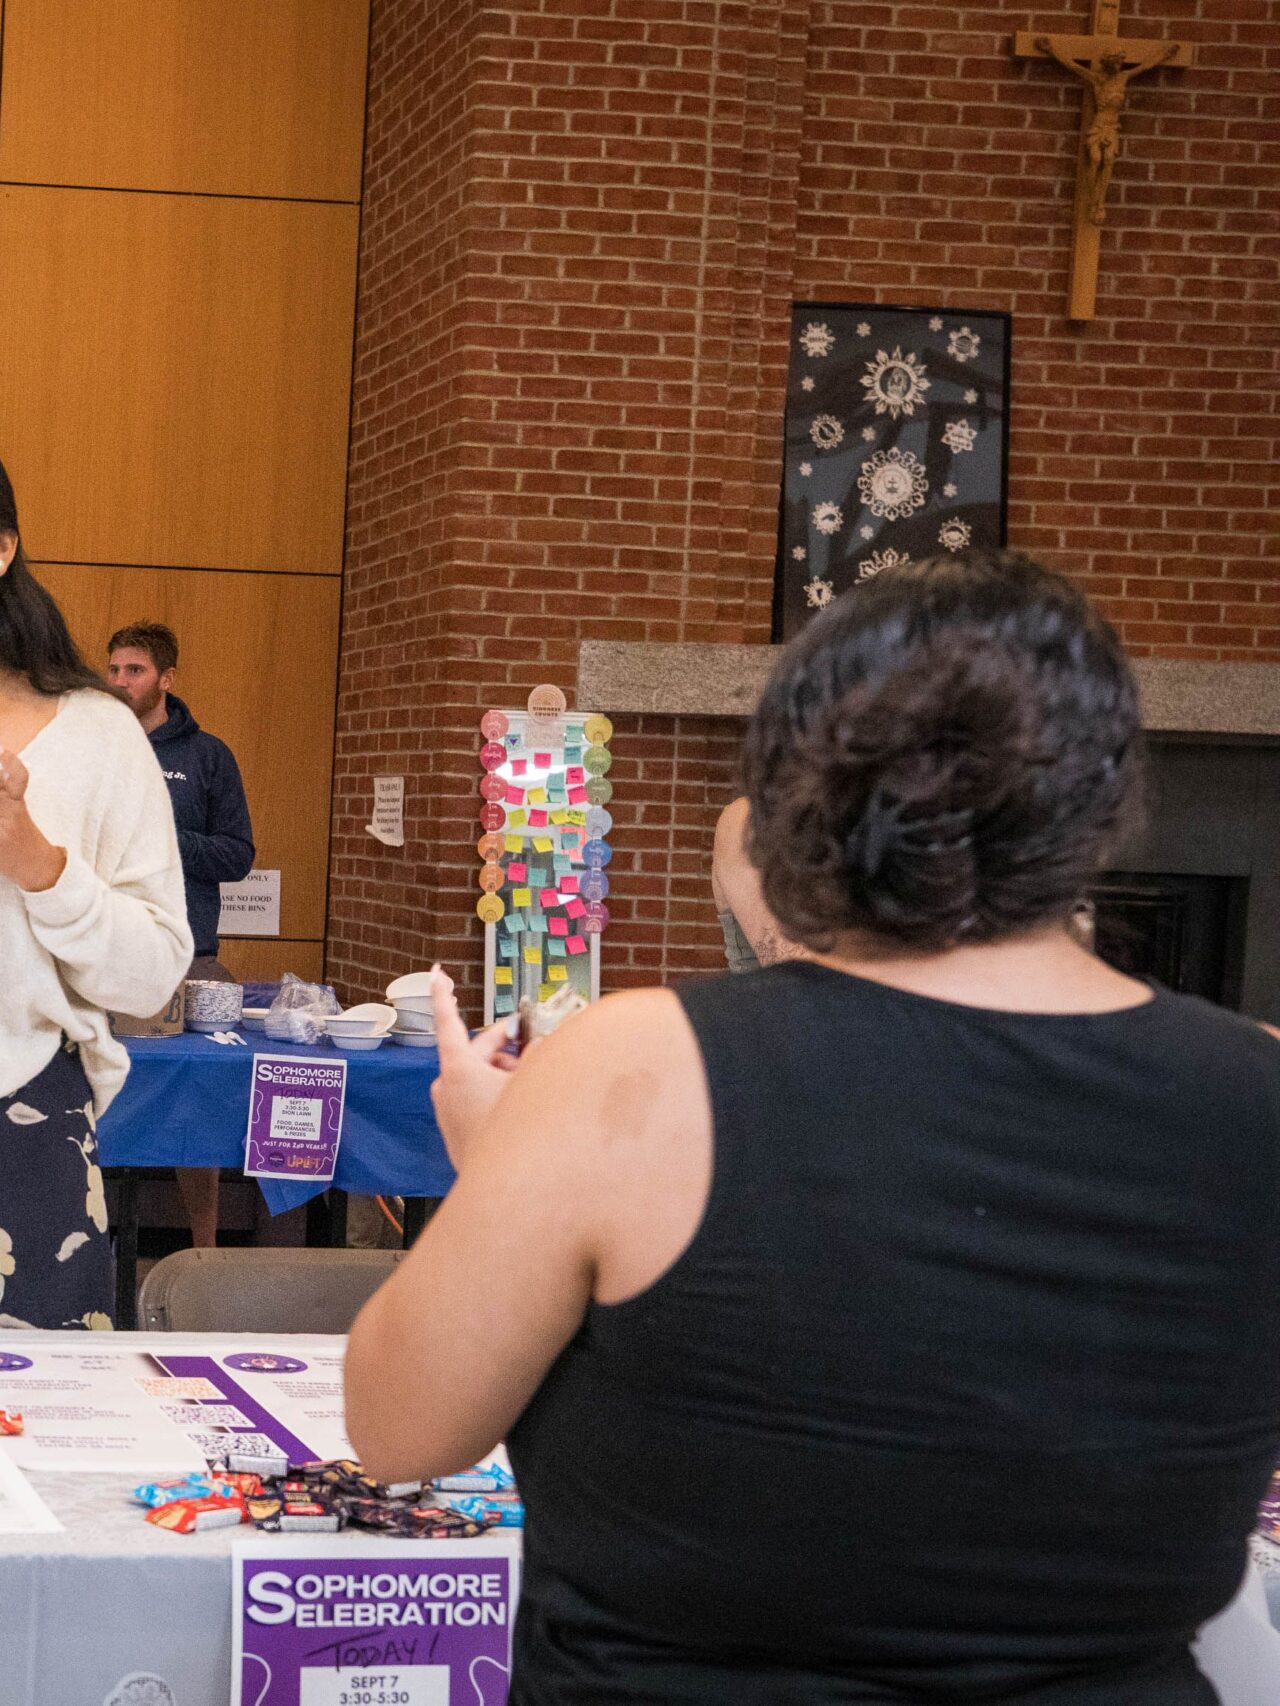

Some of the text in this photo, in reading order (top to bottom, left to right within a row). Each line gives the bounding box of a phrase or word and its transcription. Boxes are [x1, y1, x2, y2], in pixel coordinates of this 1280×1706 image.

[247, 874, 269, 882] ONLY
[250, 895, 272, 903] FOOD
[257, 1064, 341, 1081] SOPHOMORE
[351, 1676, 399, 1688] SEPT 7
[339, 1692, 410, 1706] 3:30-5:30
